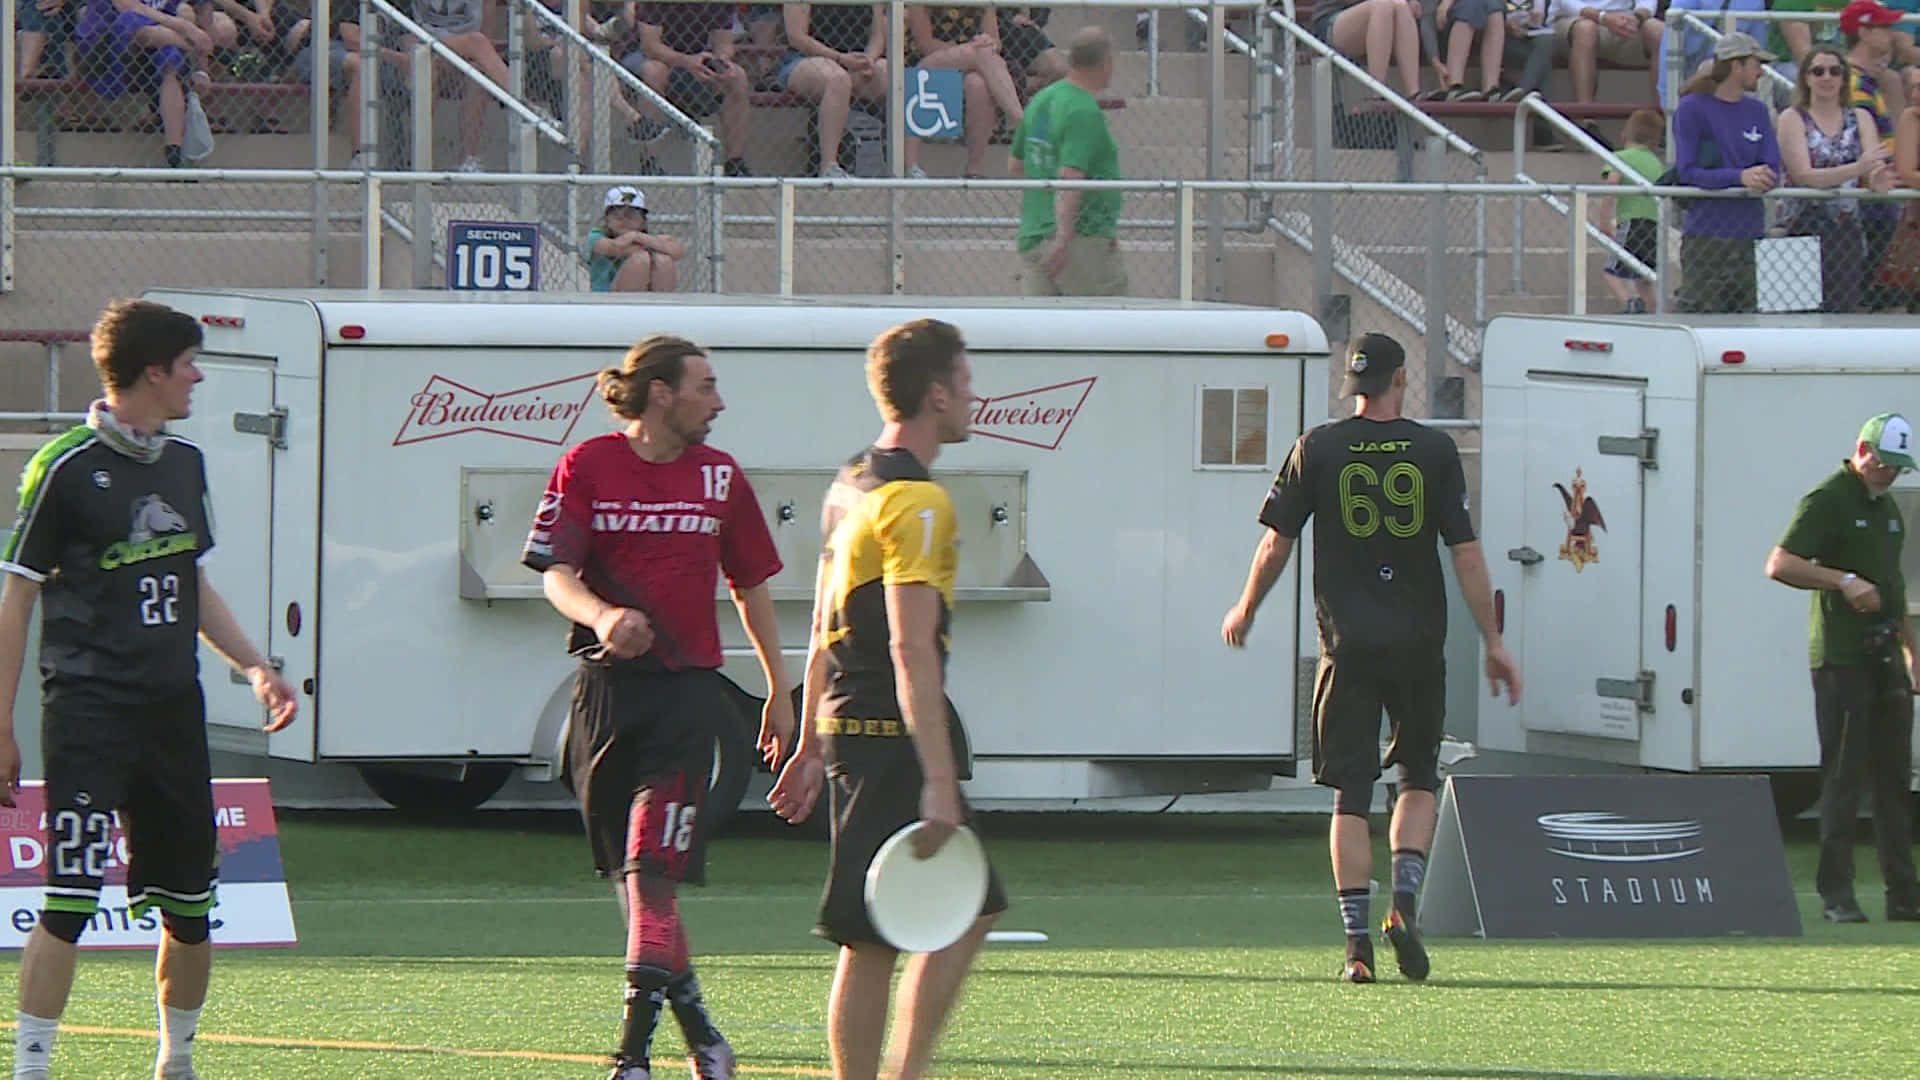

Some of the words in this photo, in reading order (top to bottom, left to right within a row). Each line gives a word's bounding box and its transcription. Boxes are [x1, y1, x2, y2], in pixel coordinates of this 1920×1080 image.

[467, 229, 521, 241] SECTION
[455, 245, 533, 289] 105
[410, 391, 580, 426] Budweiser
[970, 397, 1073, 425] dweiser
[1348, 440, 1413, 453] JAGT
[701, 464, 734, 501] 18
[1339, 462, 1425, 538] 69
[591, 513, 721, 536] AVIATOR
[139, 575, 180, 625] 22
[55, 810, 109, 876] 22
[661, 802, 697, 852] 18
[1552, 877, 1714, 904] STADIUM
